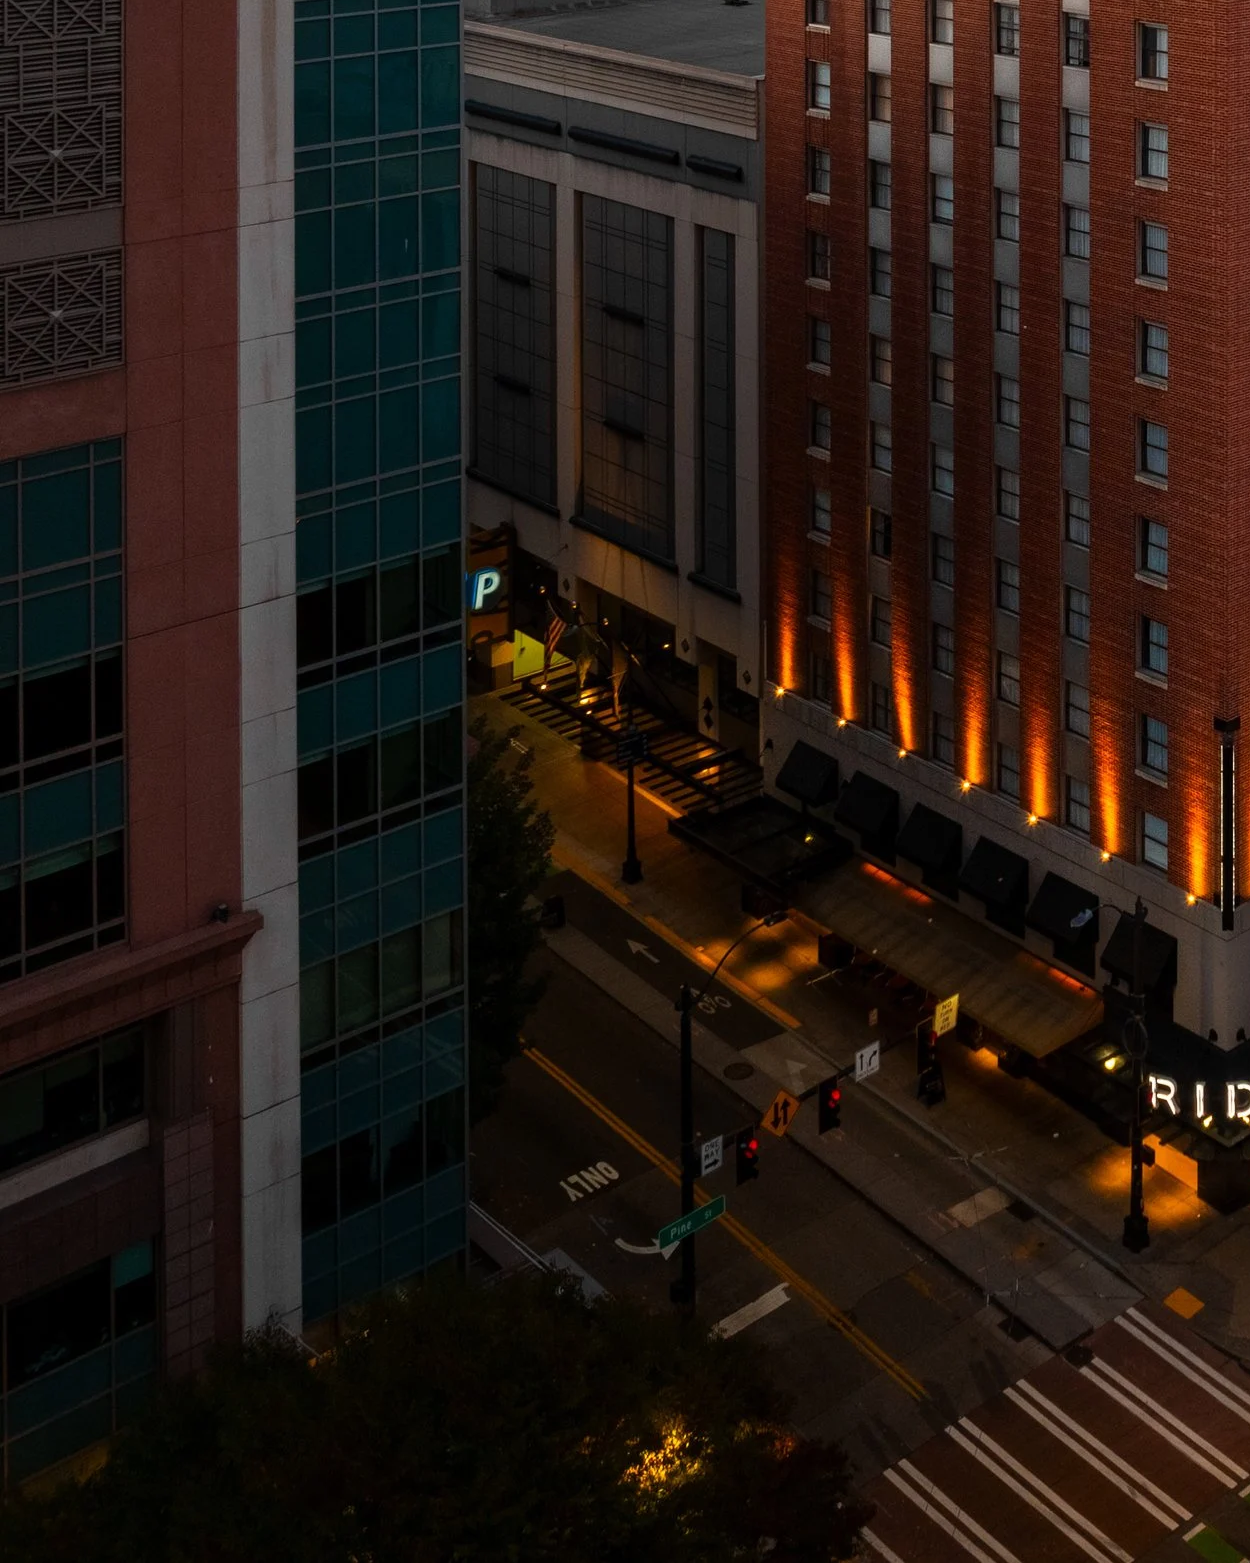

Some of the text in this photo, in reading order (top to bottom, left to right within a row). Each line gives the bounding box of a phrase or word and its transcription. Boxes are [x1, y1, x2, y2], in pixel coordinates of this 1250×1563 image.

[473, 567, 501, 610] P
[559, 1161, 619, 1202] ONLY
[670, 1220, 692, 1240] Pine
